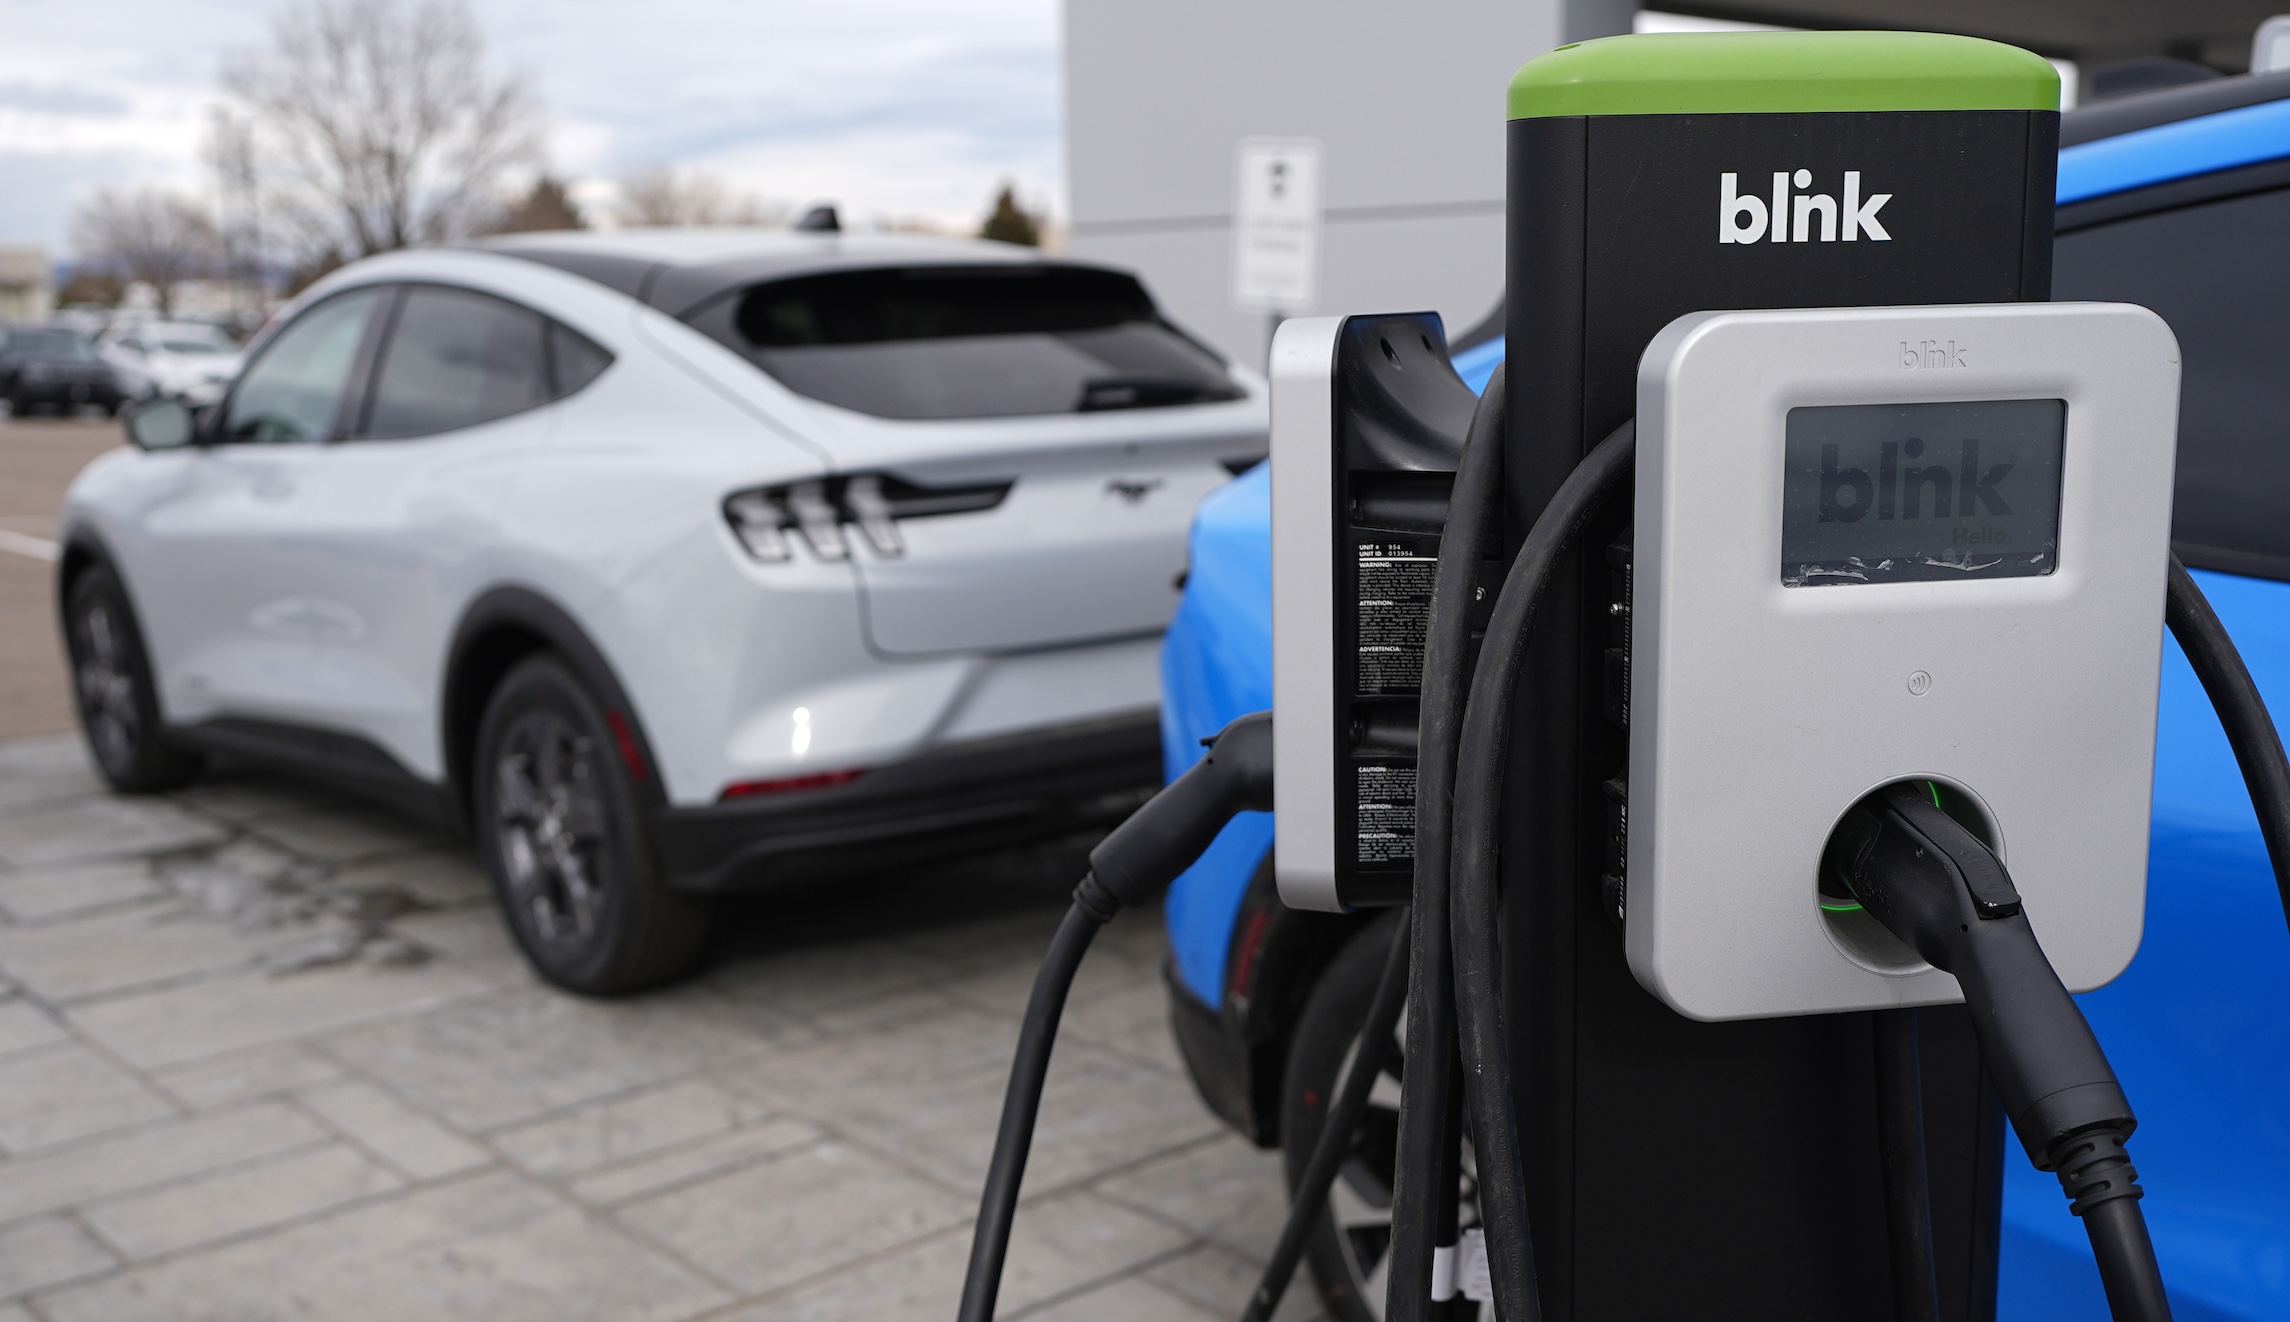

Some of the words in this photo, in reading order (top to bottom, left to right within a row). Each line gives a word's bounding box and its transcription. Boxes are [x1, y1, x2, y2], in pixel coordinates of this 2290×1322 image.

[1719, 168, 1893, 245] blink
[1899, 340, 1967, 371] blink
[1819, 437, 2016, 523] blink
[1952, 525, 2013, 545] Hello.
